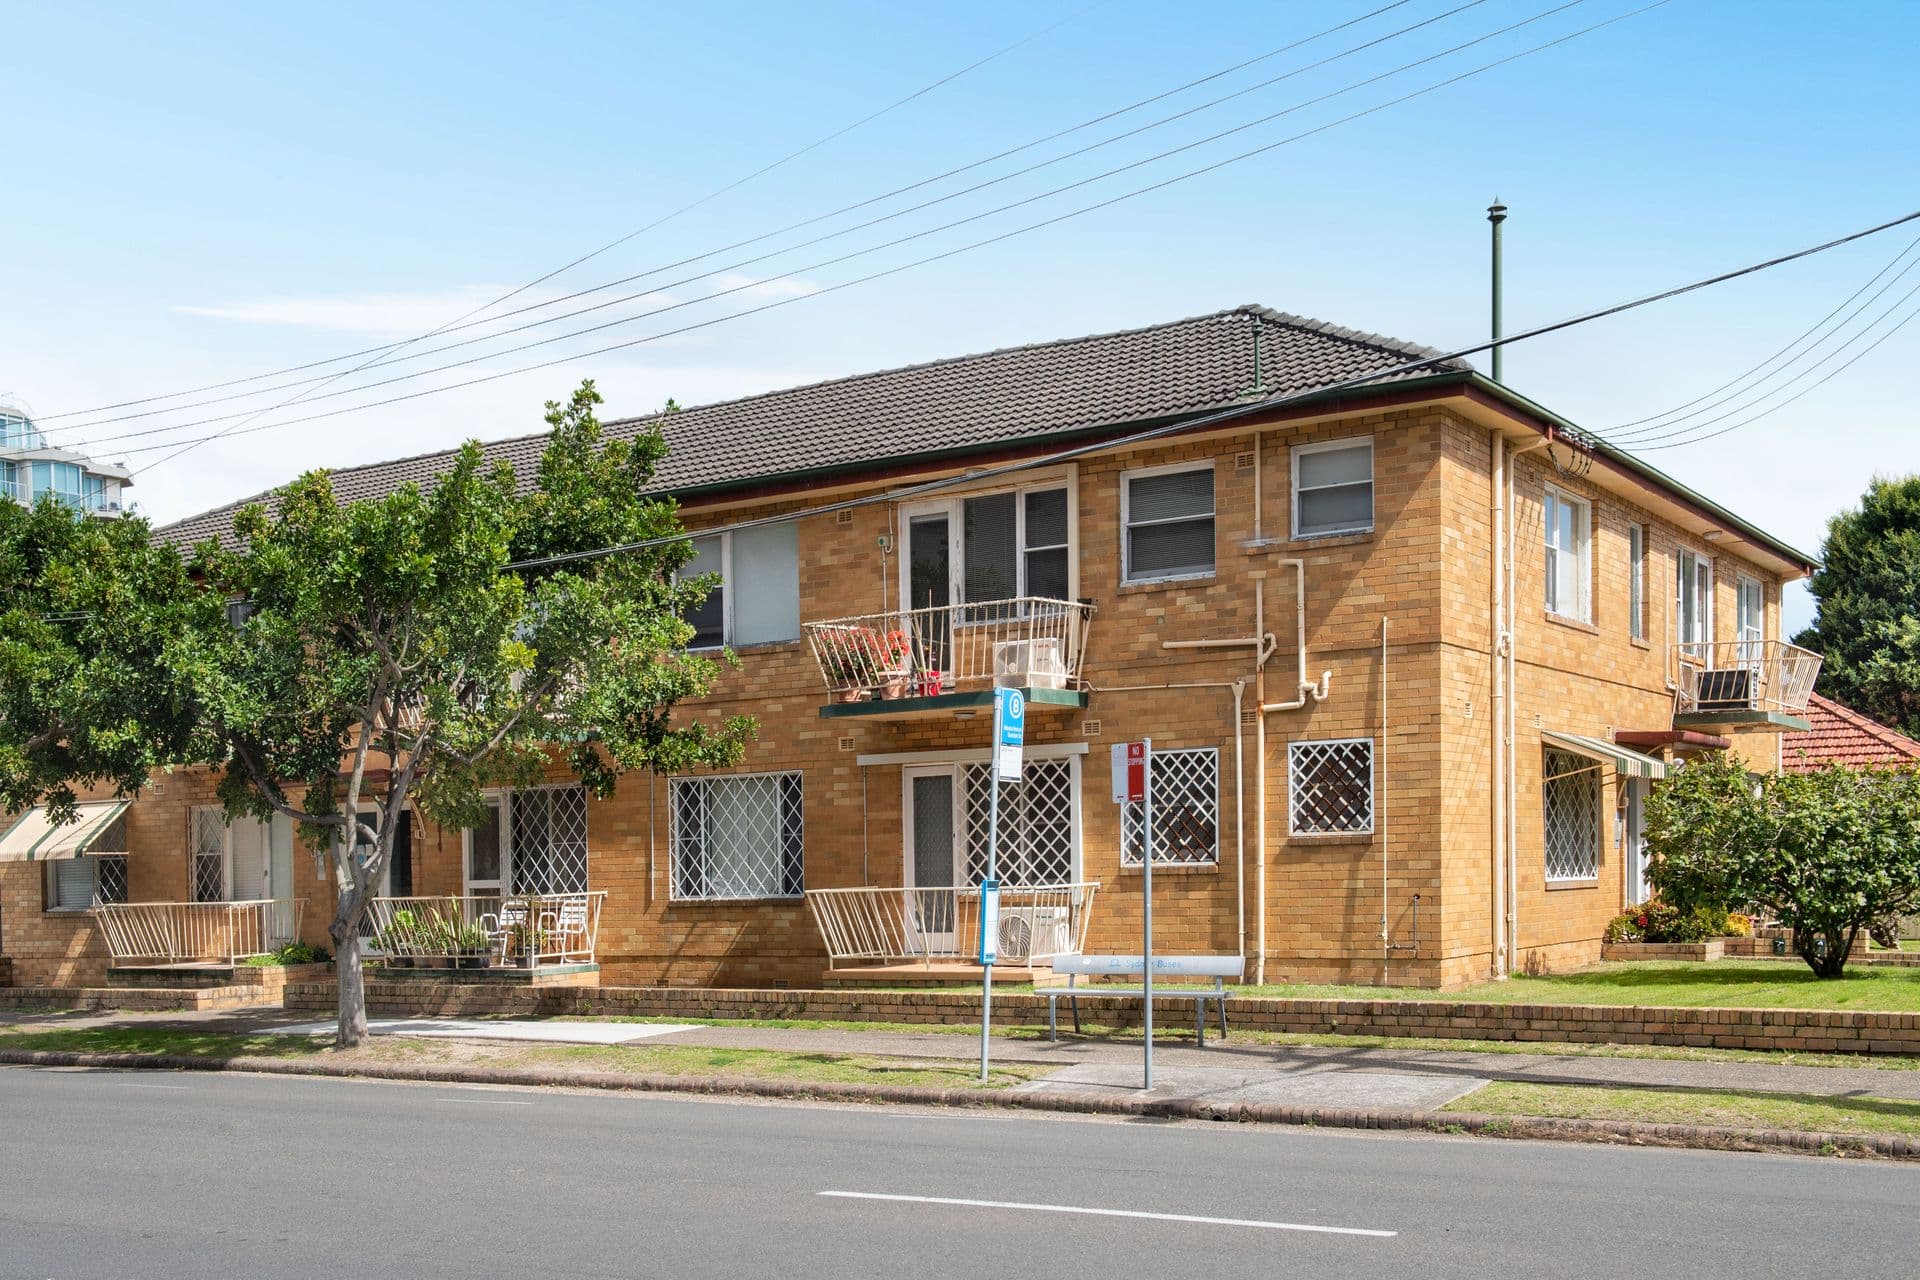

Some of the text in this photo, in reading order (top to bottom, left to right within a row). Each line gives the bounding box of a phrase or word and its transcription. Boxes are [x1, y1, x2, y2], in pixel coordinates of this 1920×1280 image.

[1013, 699, 1020, 713] B
[1132, 746, 1140, 755] NO
[1126, 959, 1155, 969] Sydn
